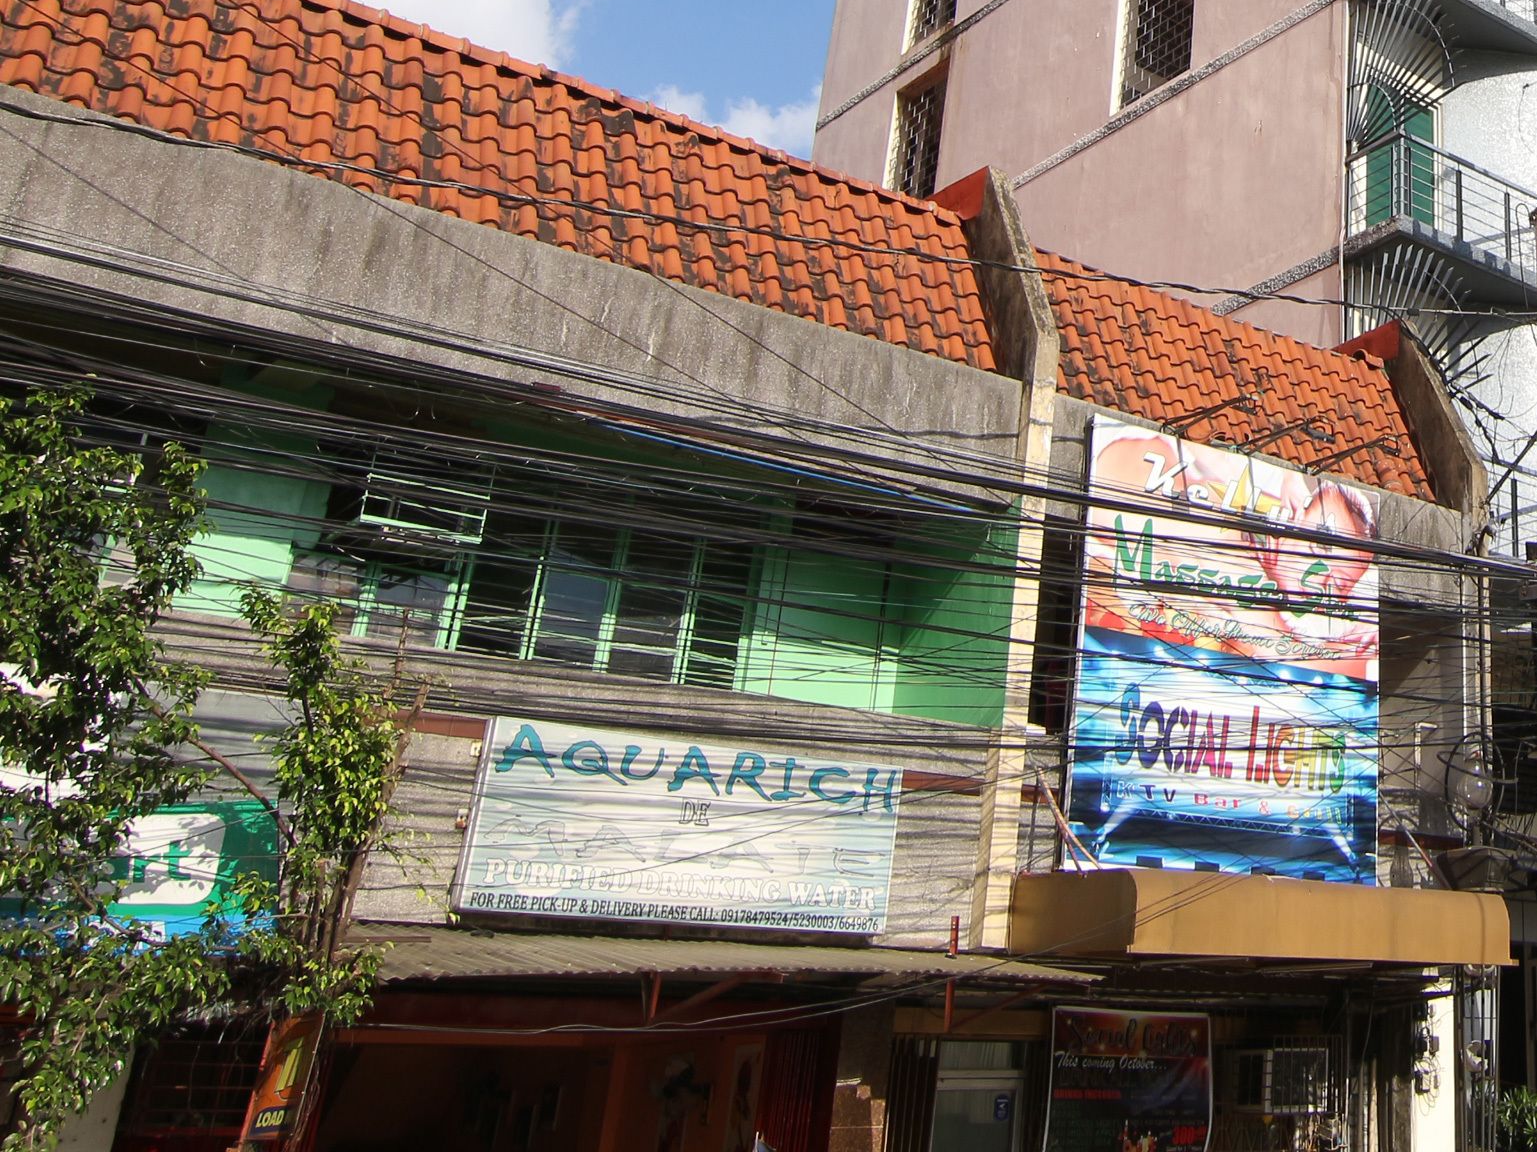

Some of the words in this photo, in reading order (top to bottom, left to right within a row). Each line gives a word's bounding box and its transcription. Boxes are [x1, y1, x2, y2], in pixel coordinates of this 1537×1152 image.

[1115, 682, 1233, 779] SOCIAL
[1246, 705, 1346, 794] LIGHTS
[495, 724, 898, 813] AQUARICH
[678, 797, 712, 827] DE
[1259, 800, 1272, 816] &
[483, 858, 632, 897] PURIFIED
[637, 870, 782, 905] DRINKING
[788, 882, 877, 911] WATER
[469, 892, 494, 909] FOR
[497, 893, 528, 910] FREE
[531, 895, 578, 913] PICK-UP
[579, 900, 589, 914] &
[590, 900, 647, 917] DELIVERY
[647, 903, 689, 921] PLEASE
[1055, 1050, 1079, 1069] This
[255, 1109, 285, 1128] LOAD
